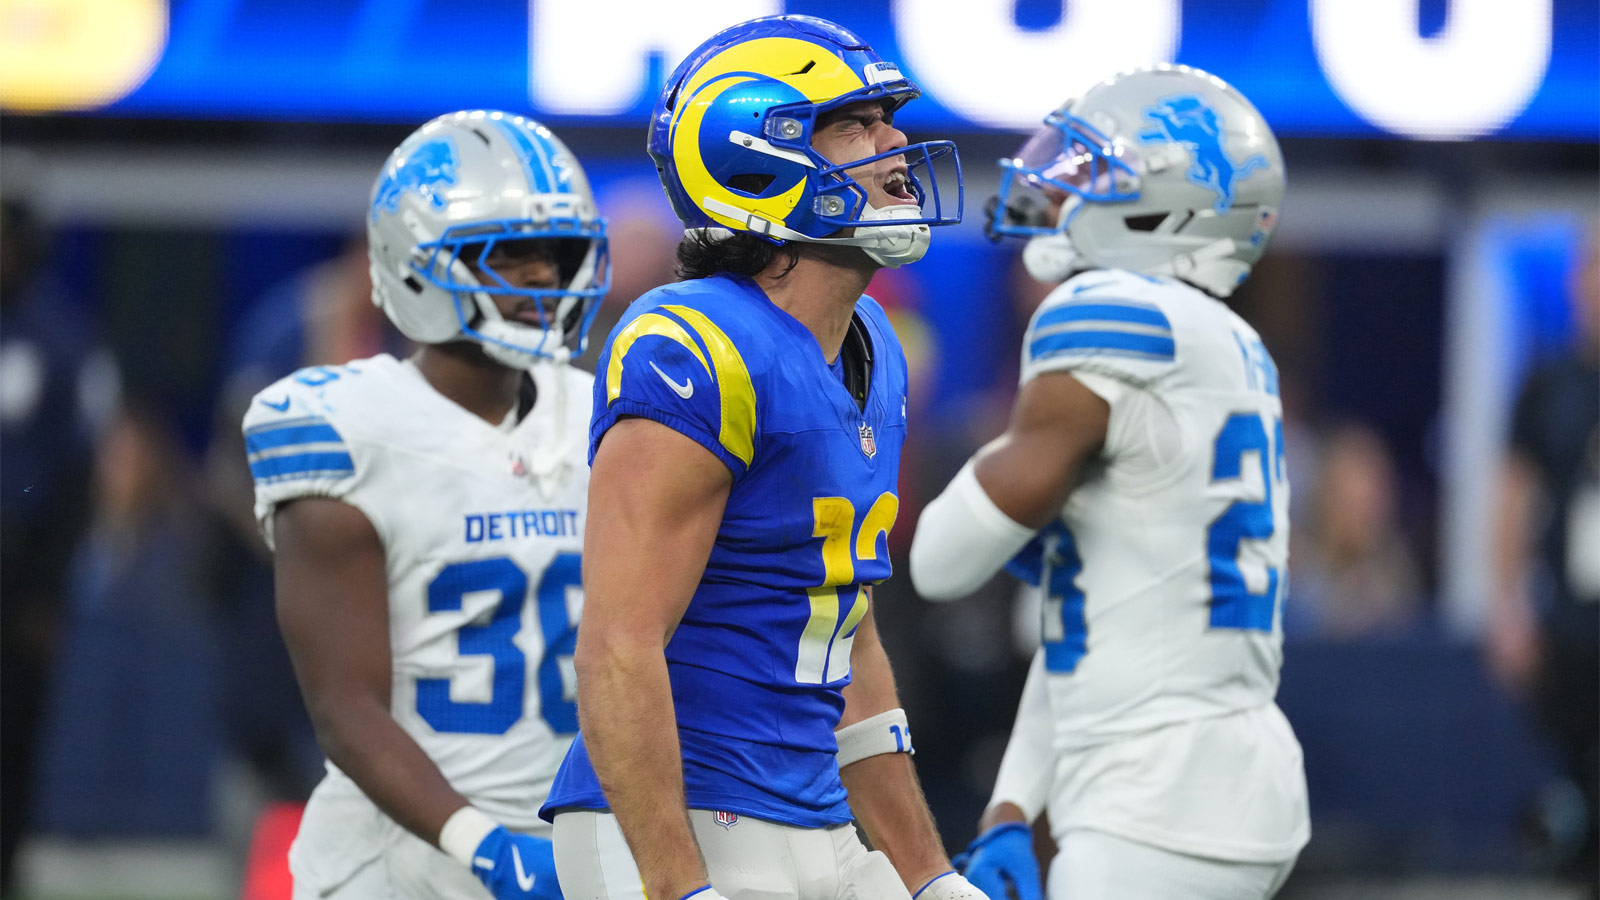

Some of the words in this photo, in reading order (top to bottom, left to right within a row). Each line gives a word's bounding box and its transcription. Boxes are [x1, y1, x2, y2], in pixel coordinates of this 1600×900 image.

[465, 509, 578, 543] DETROIT
[1207, 412, 1289, 632] 2
[795, 491, 899, 684] 12
[718, 811, 737, 823] NFL
